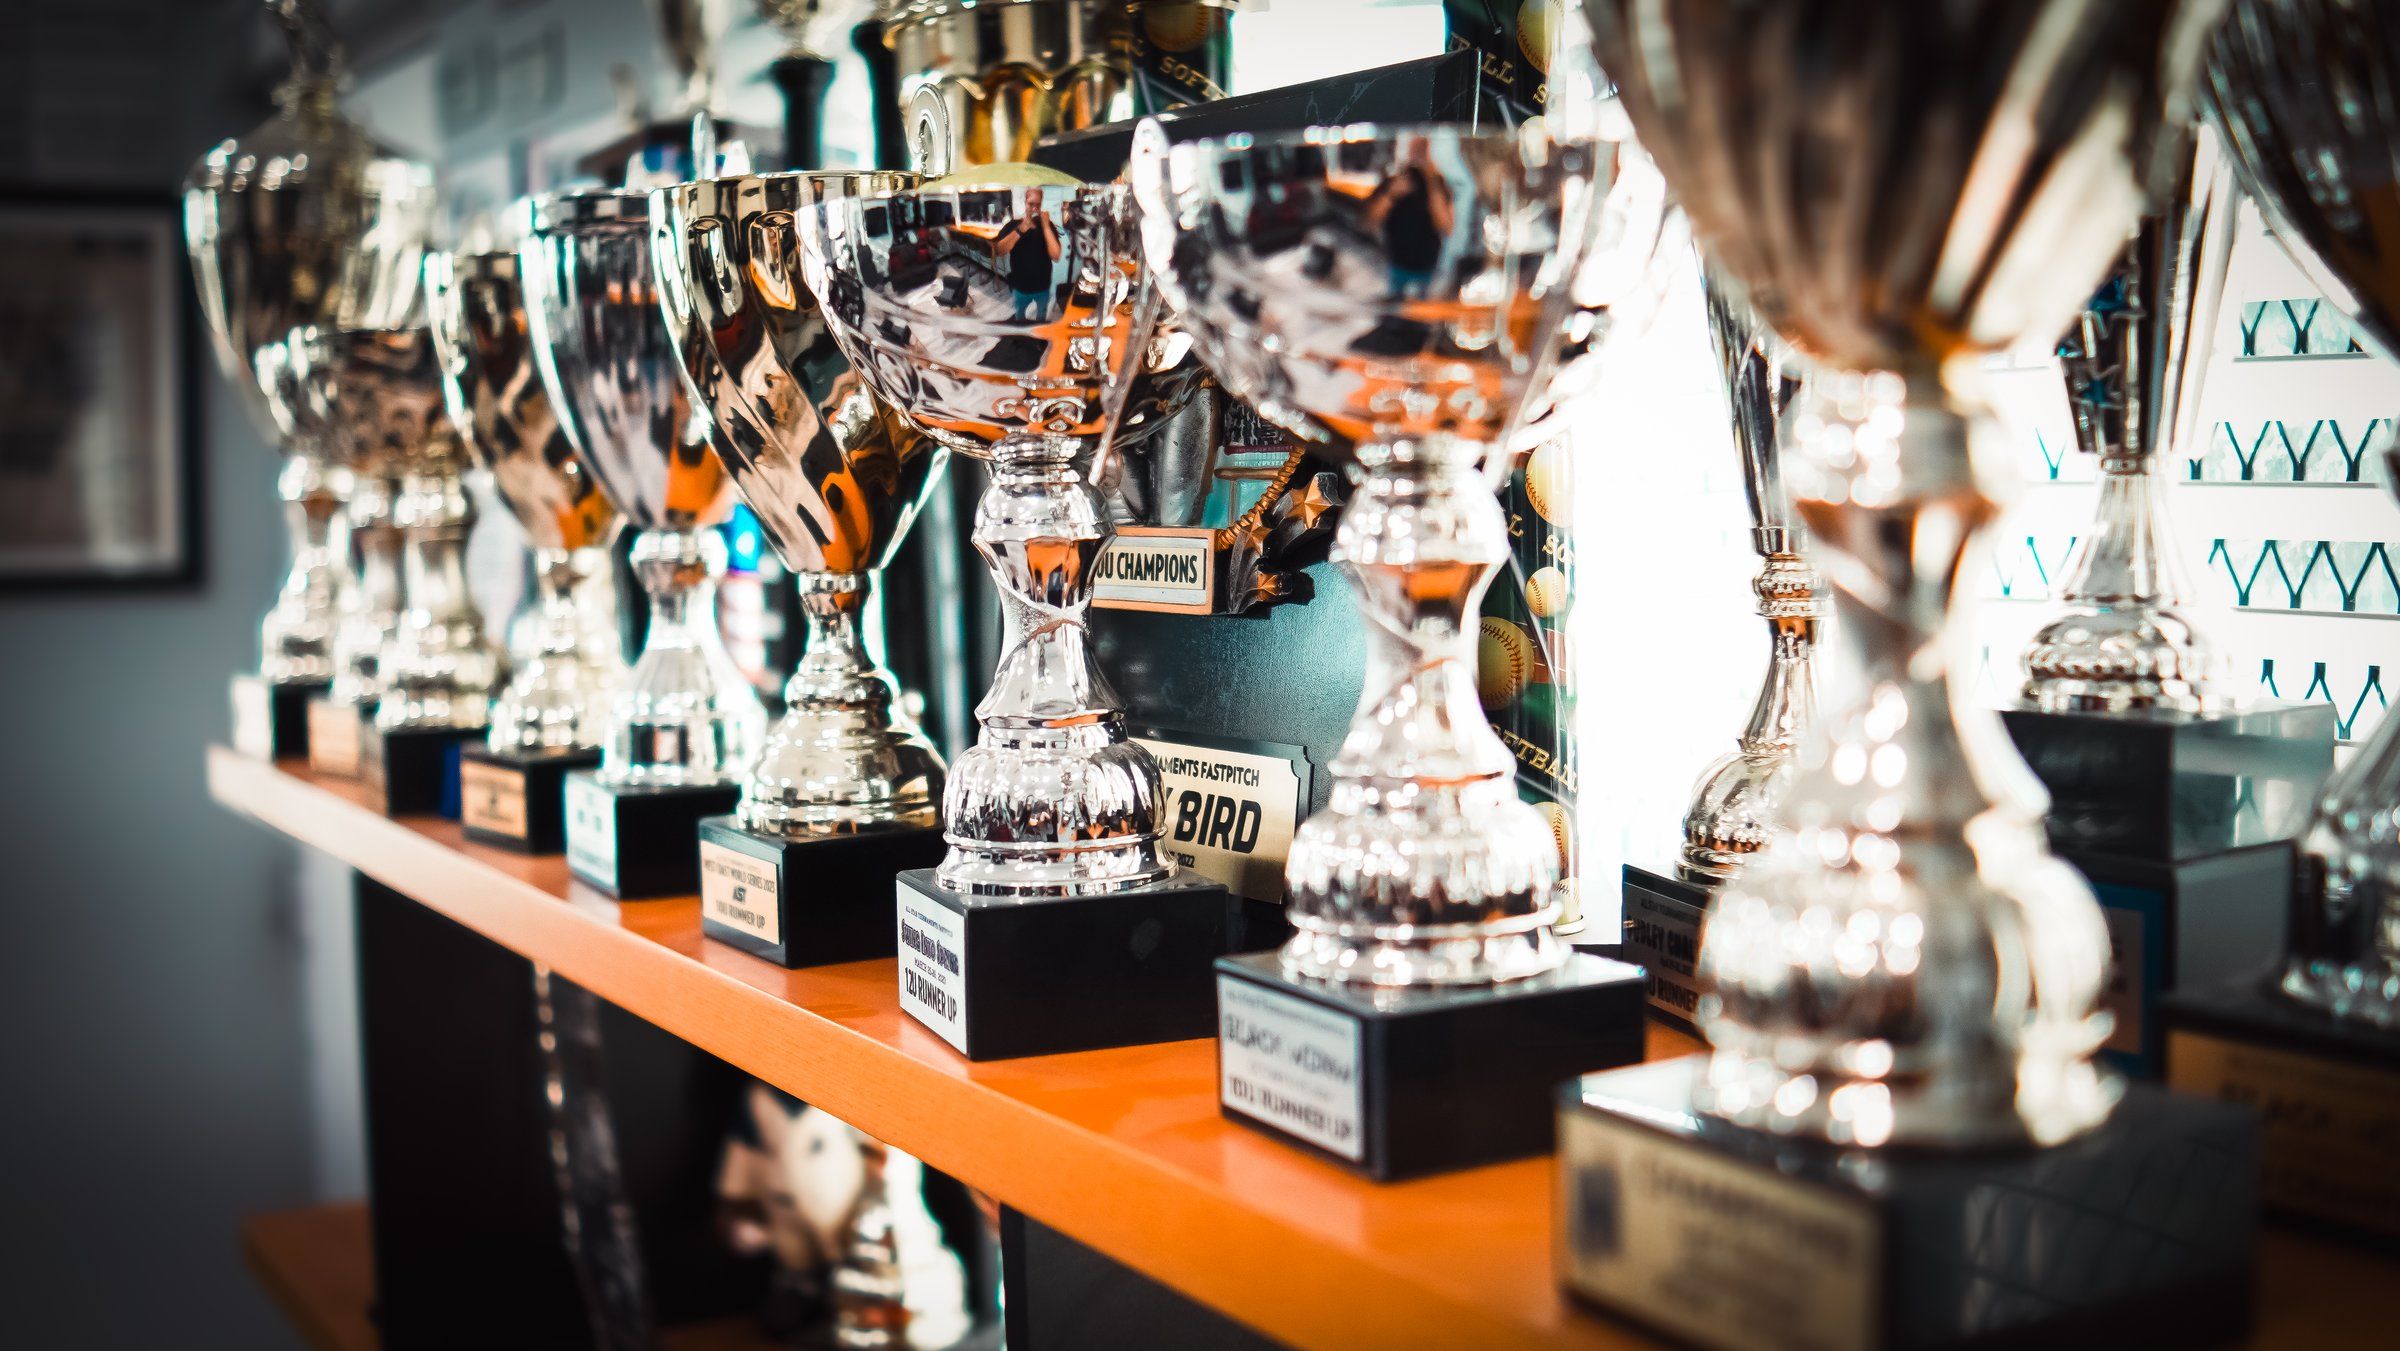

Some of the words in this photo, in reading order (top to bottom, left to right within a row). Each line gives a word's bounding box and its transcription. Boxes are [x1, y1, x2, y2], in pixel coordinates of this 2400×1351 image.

[1117, 552, 1198, 584] CHAMPIONS
[1200, 761, 1260, 787] FASTPITCH
[1173, 789, 1262, 854] BIRD
[747, 872, 763, 890] SERIES
[729, 904, 755, 927] RUNNER
[756, 914, 766, 929] UP
[905, 966, 917, 998] 12U
[918, 977, 947, 1019] RUNNER
[947, 996, 958, 1024] UP
